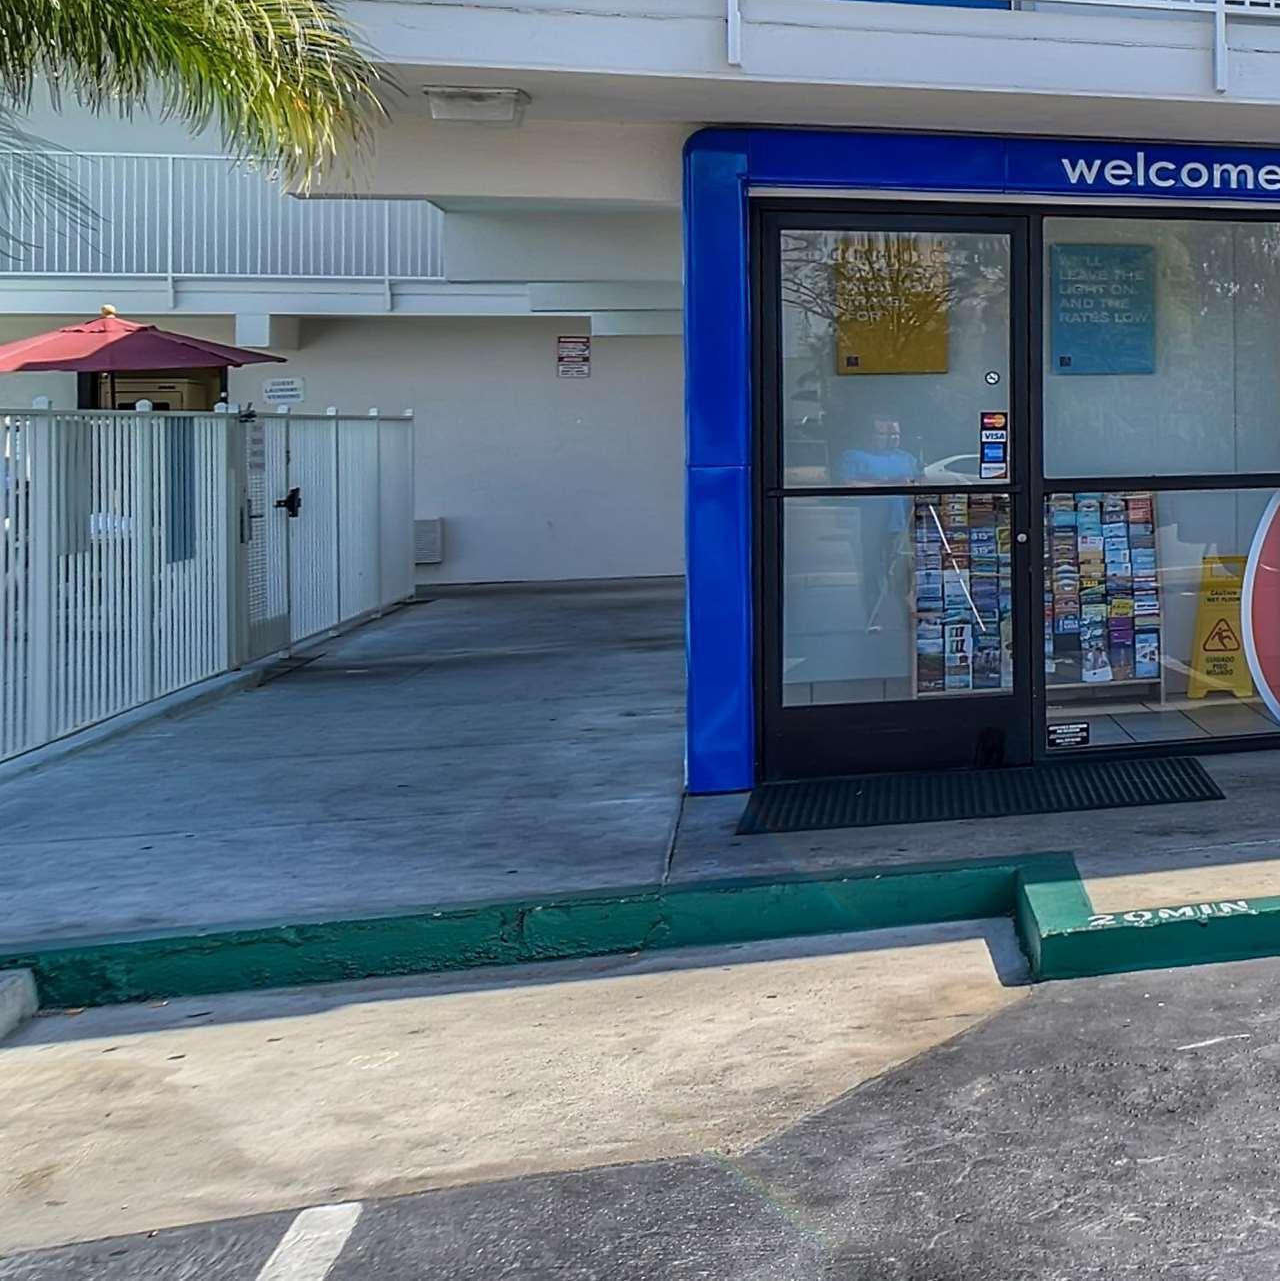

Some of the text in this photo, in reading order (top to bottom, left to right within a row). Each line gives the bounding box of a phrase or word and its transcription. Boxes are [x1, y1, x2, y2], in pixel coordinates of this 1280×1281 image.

[1060, 284, 1106, 295] LIGHT
[1060, 299, 1094, 309] AND
[1060, 312, 1110, 323] RATES
[984, 432, 1005, 440] VISA
